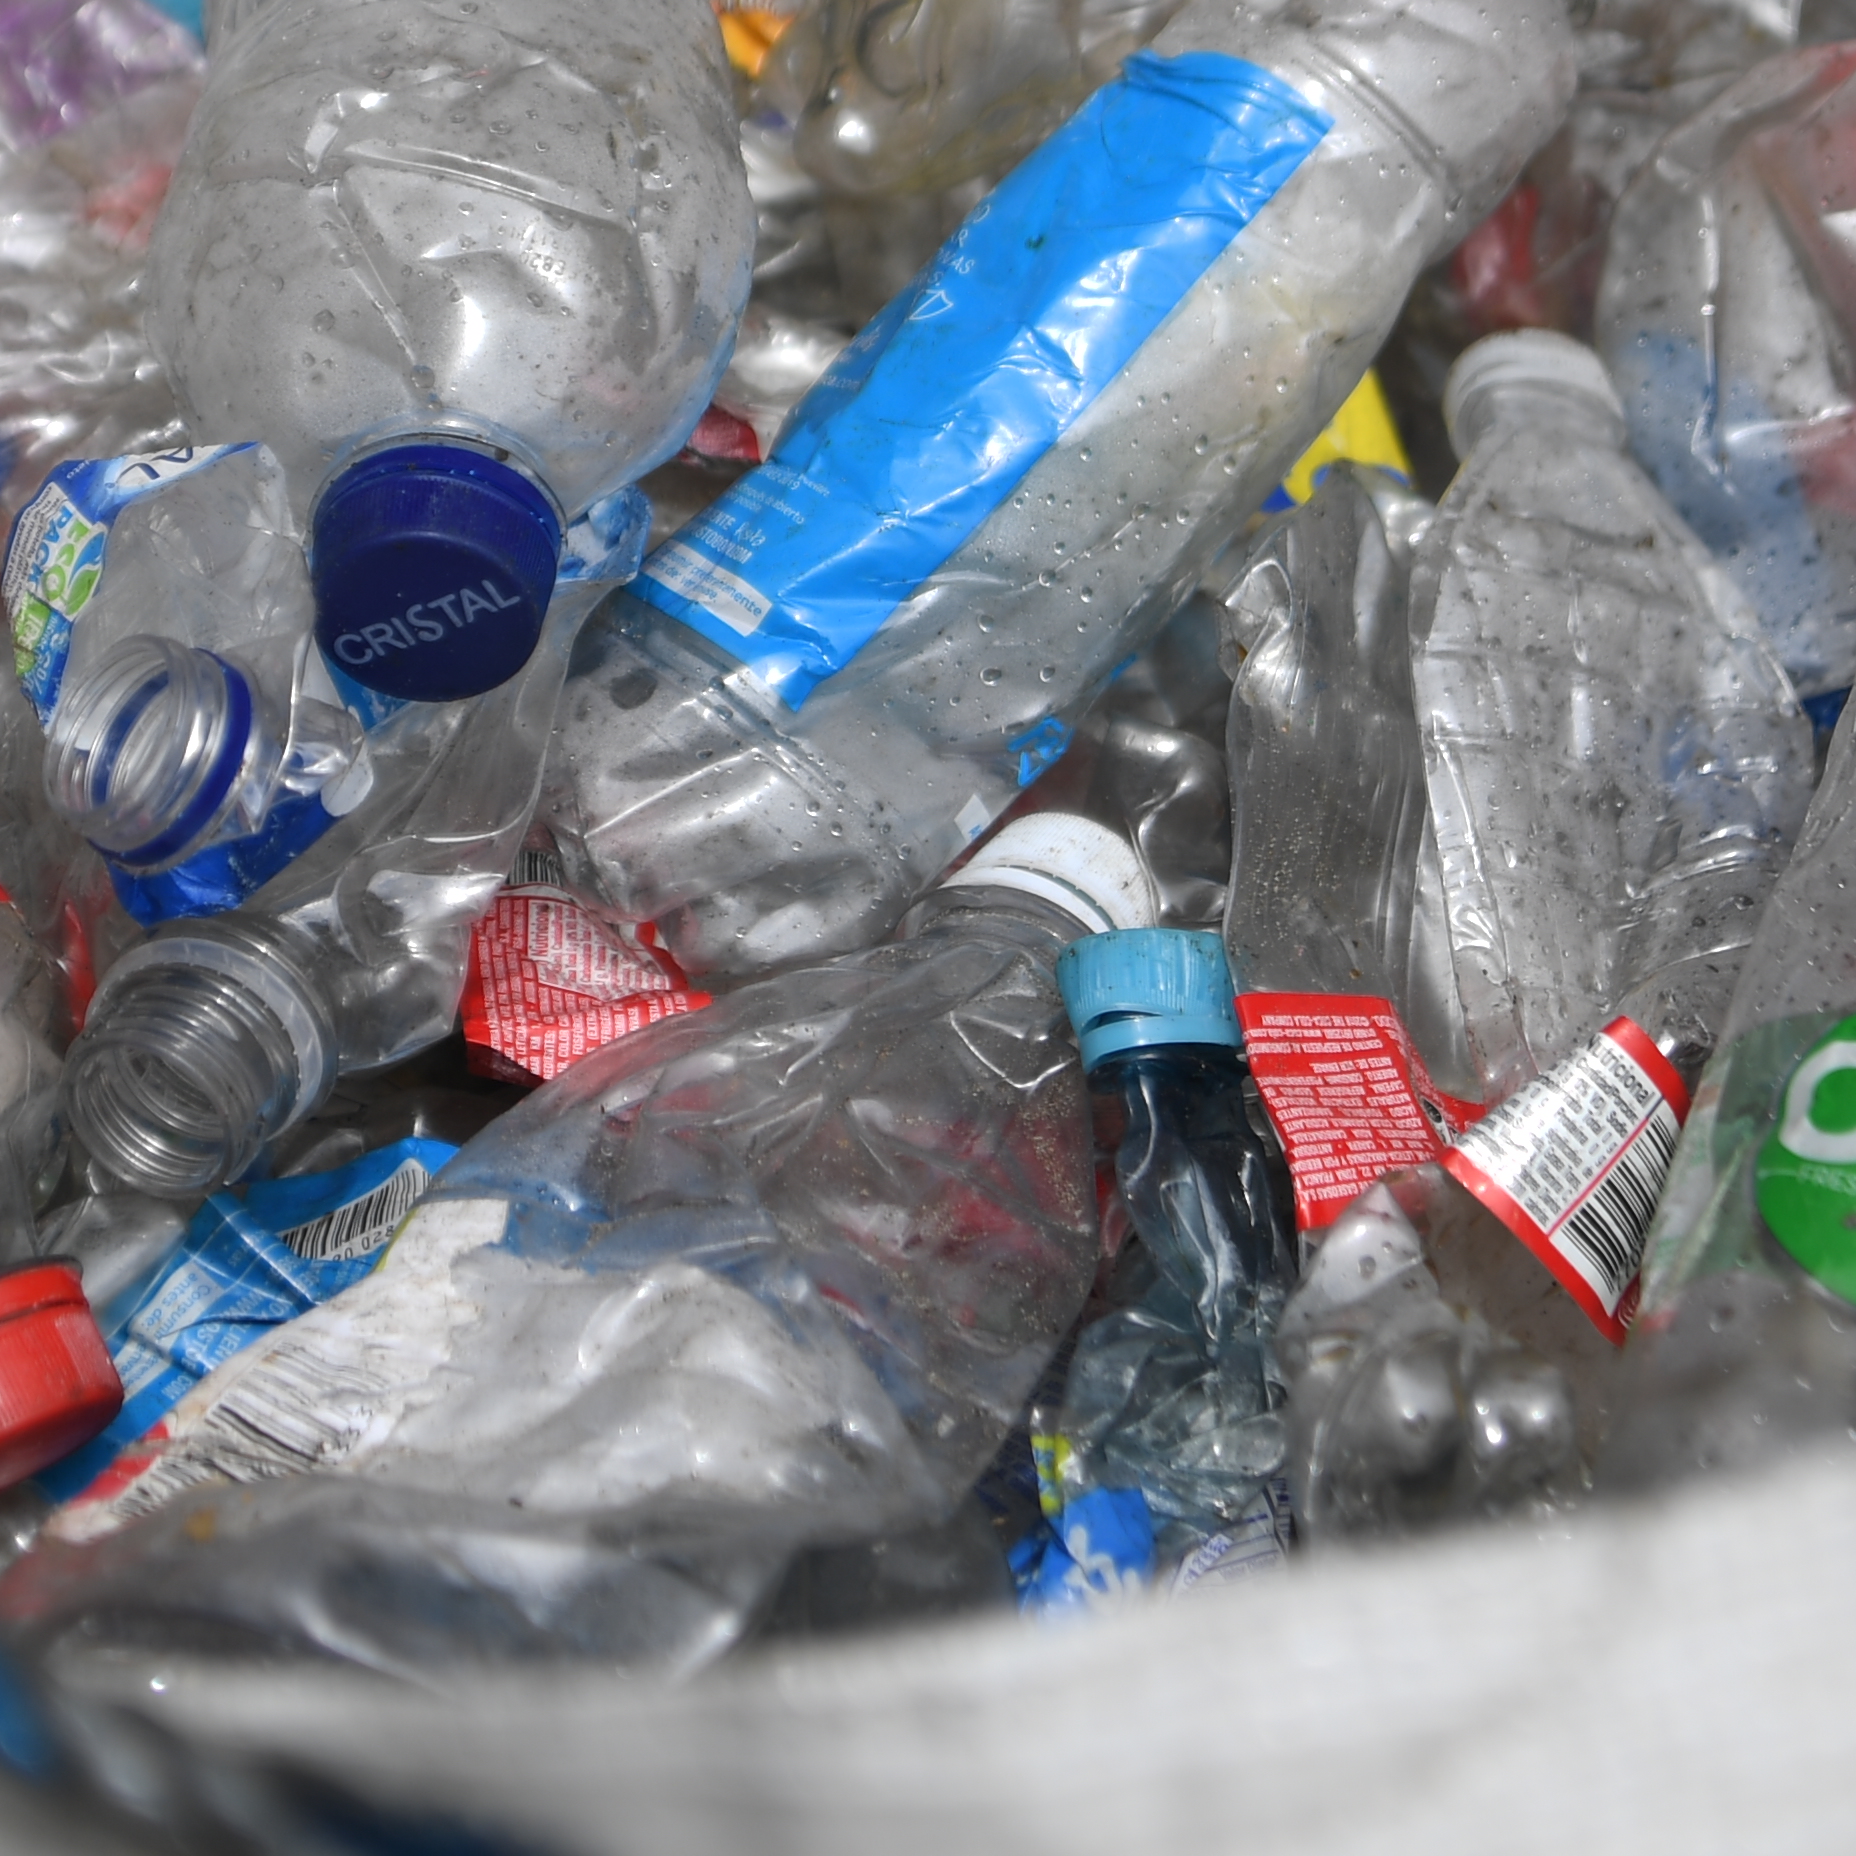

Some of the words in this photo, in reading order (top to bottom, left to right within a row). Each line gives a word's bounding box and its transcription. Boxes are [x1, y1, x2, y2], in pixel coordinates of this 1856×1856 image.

[30, 506, 73, 583] PACK
[43, 519, 88, 601] ECO
[333, 578, 521, 668] CRISTAL
[529, 902, 547, 955] Nutricionl
[1585, 1033, 1657, 1106] Nutricional
